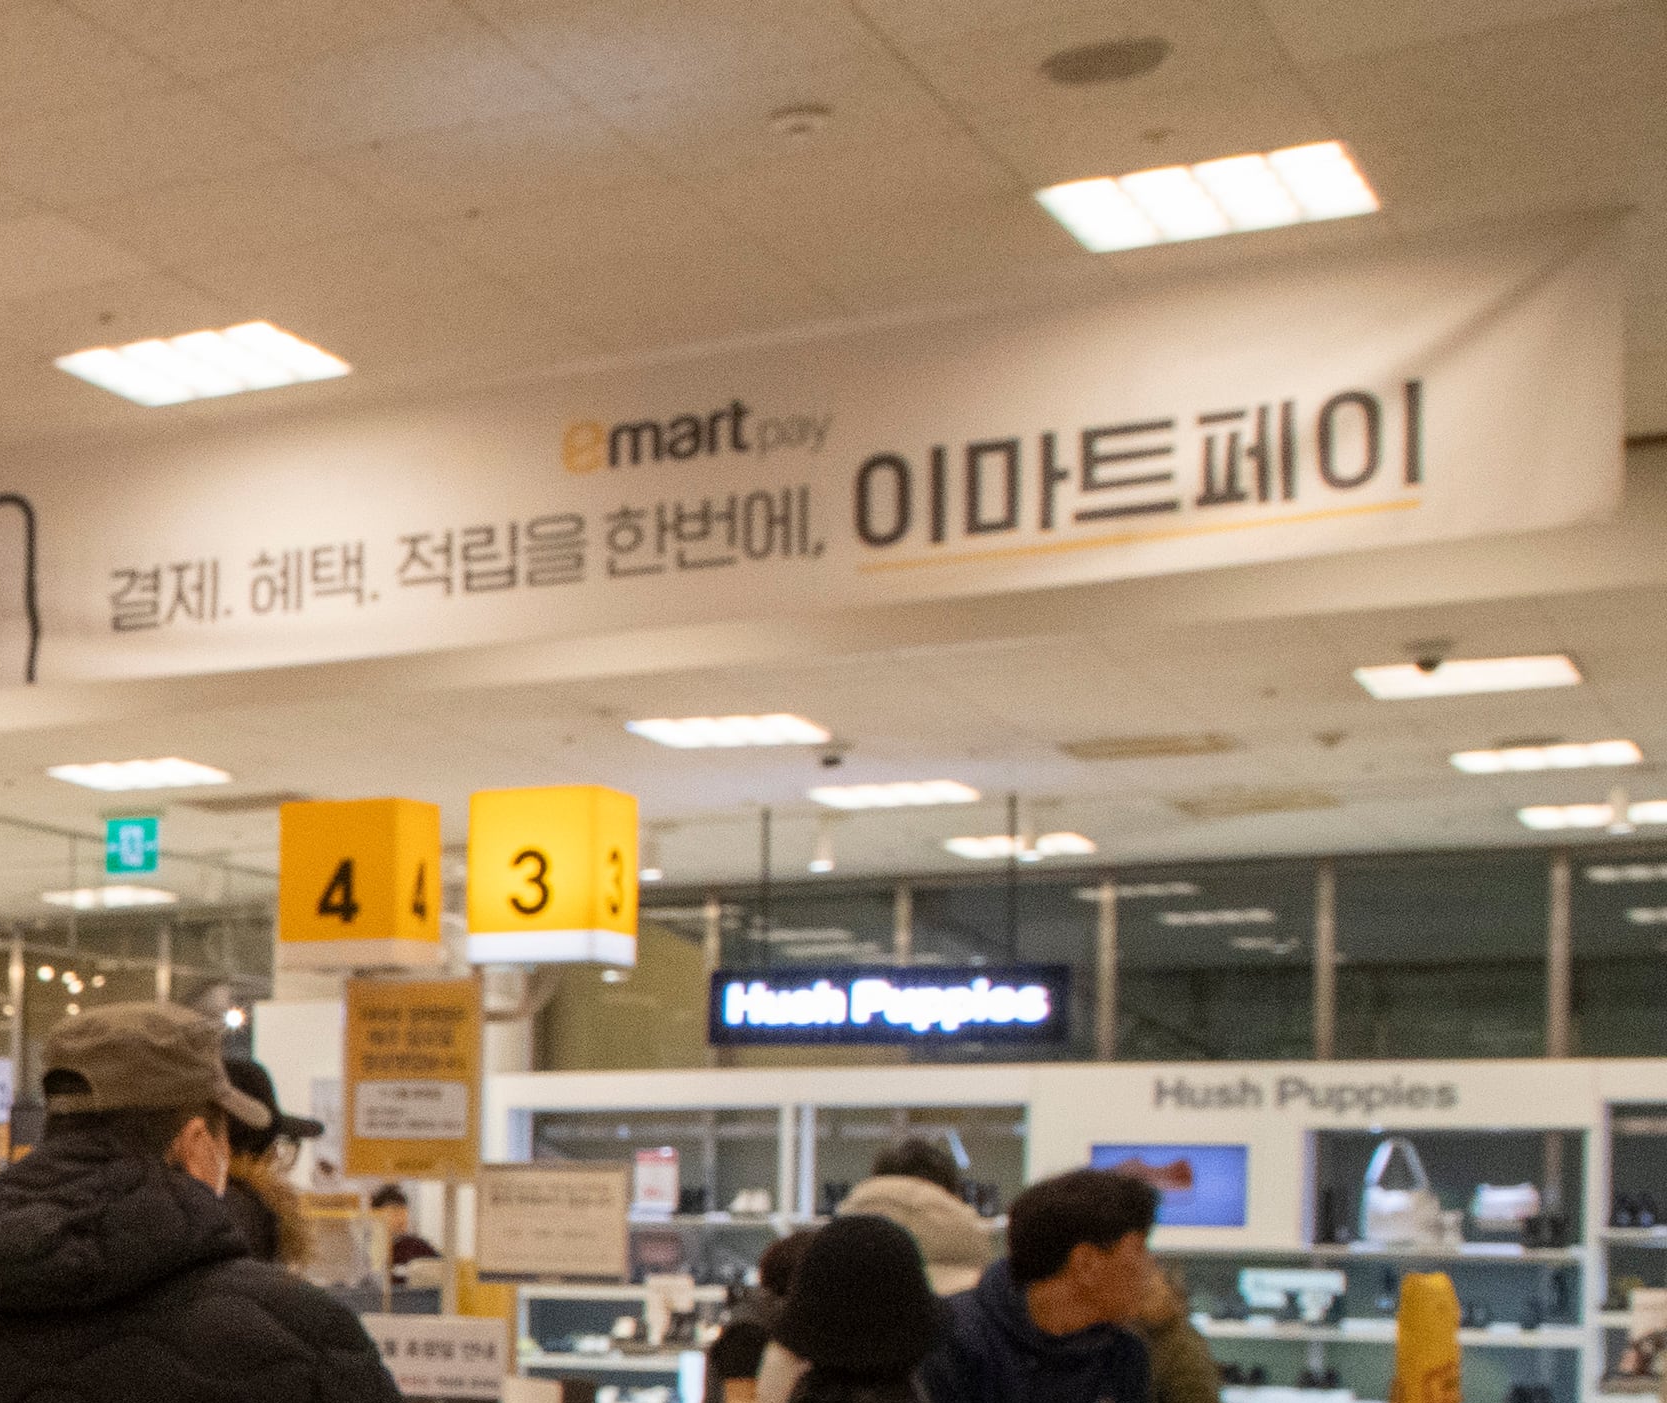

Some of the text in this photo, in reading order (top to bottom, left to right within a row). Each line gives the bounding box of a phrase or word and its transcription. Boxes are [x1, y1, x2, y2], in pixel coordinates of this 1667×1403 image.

[563, 398, 834, 474] emart pay
[398, 513, 588, 596] 적립을
[604, 486, 827, 579] 한번에,
[853, 380, 1424, 549] 이마트페이
[316, 859, 360, 924] 4
[510, 850, 550, 915] 3
[724, 977, 1051, 1034] Hush Puppies
[1153, 1077, 1459, 1117] Hush Puppies
